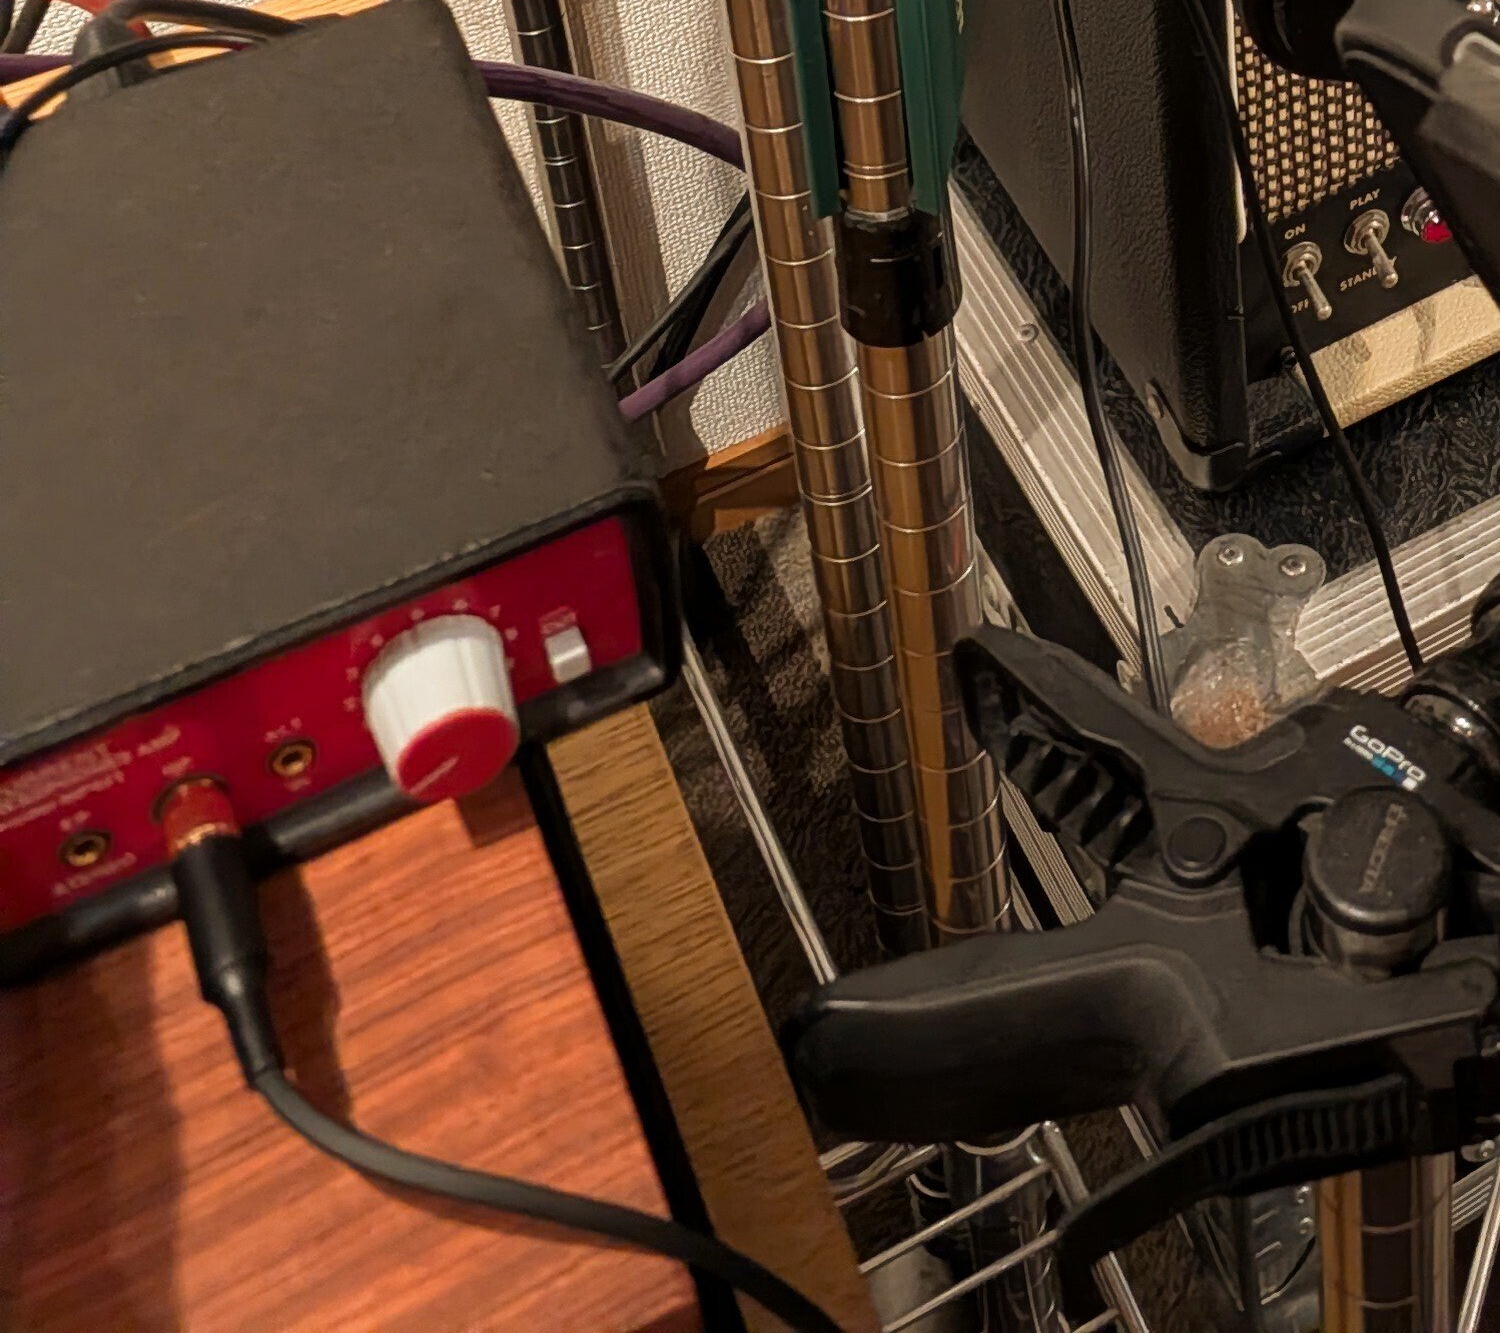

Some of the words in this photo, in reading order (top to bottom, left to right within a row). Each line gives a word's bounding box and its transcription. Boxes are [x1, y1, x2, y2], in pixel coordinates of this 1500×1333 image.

[1349, 188, 1380, 211] PLAY
[1284, 222, 1306, 240] ON
[1350, 724, 1427, 783] GoPro
